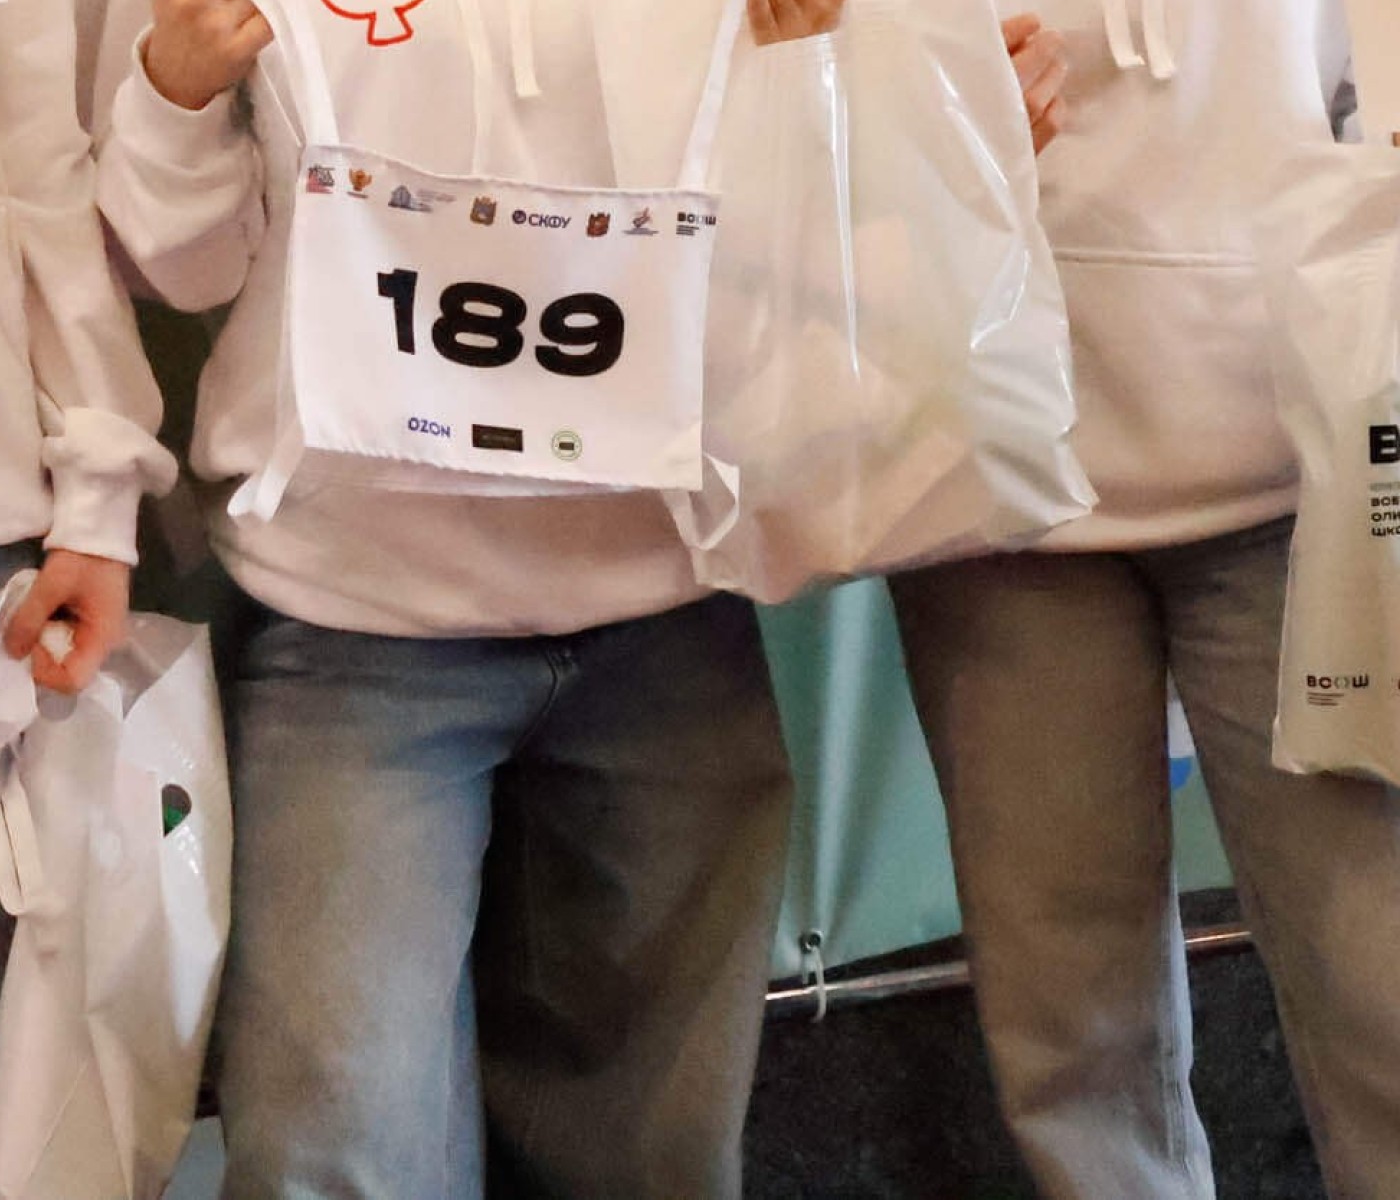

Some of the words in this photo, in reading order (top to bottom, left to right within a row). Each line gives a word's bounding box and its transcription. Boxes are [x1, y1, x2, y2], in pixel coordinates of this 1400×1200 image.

[528, 213, 572, 229] СКФУ
[377, 268, 625, 377] 189
[408, 417, 451, 437] OZON
